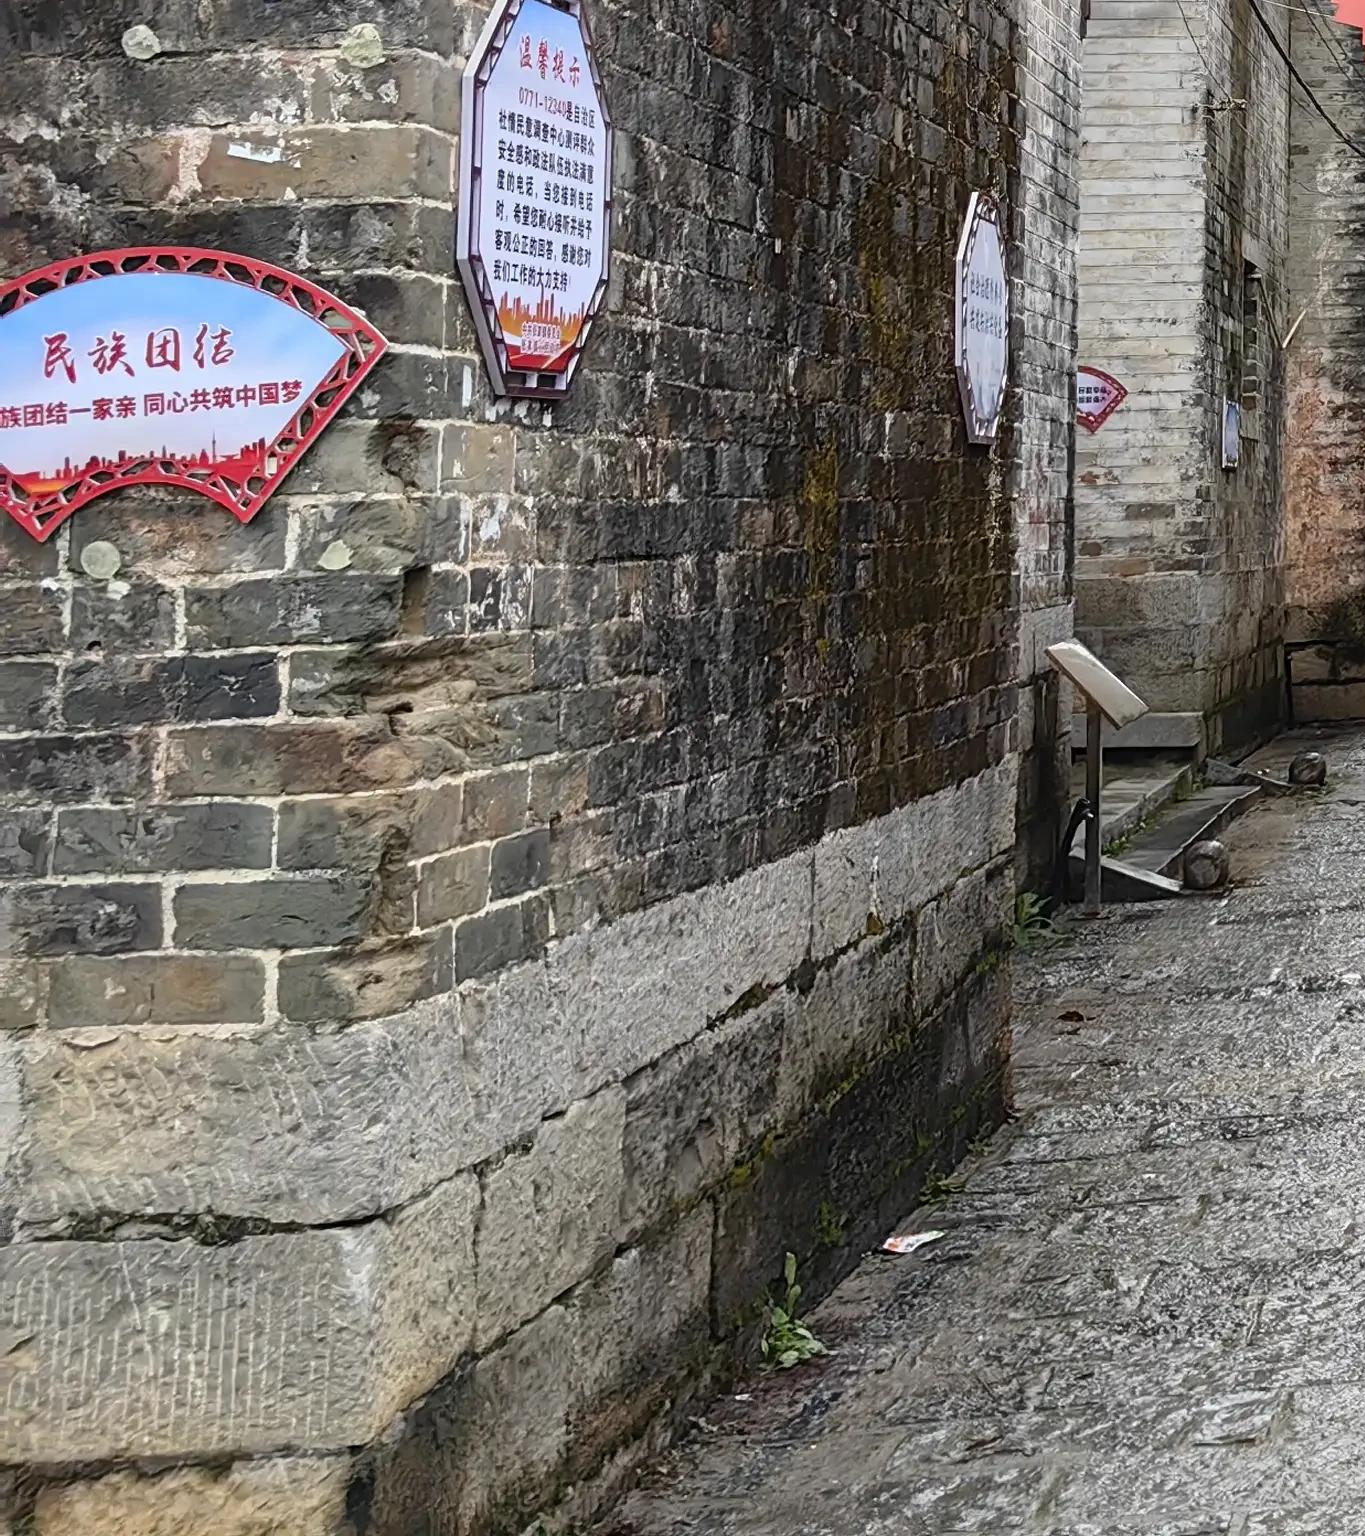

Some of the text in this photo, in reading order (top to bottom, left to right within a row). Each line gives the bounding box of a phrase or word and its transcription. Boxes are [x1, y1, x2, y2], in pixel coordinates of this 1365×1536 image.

[519, 34, 581, 88] 温馨提示
[43, 323, 236, 384] 民族团结
